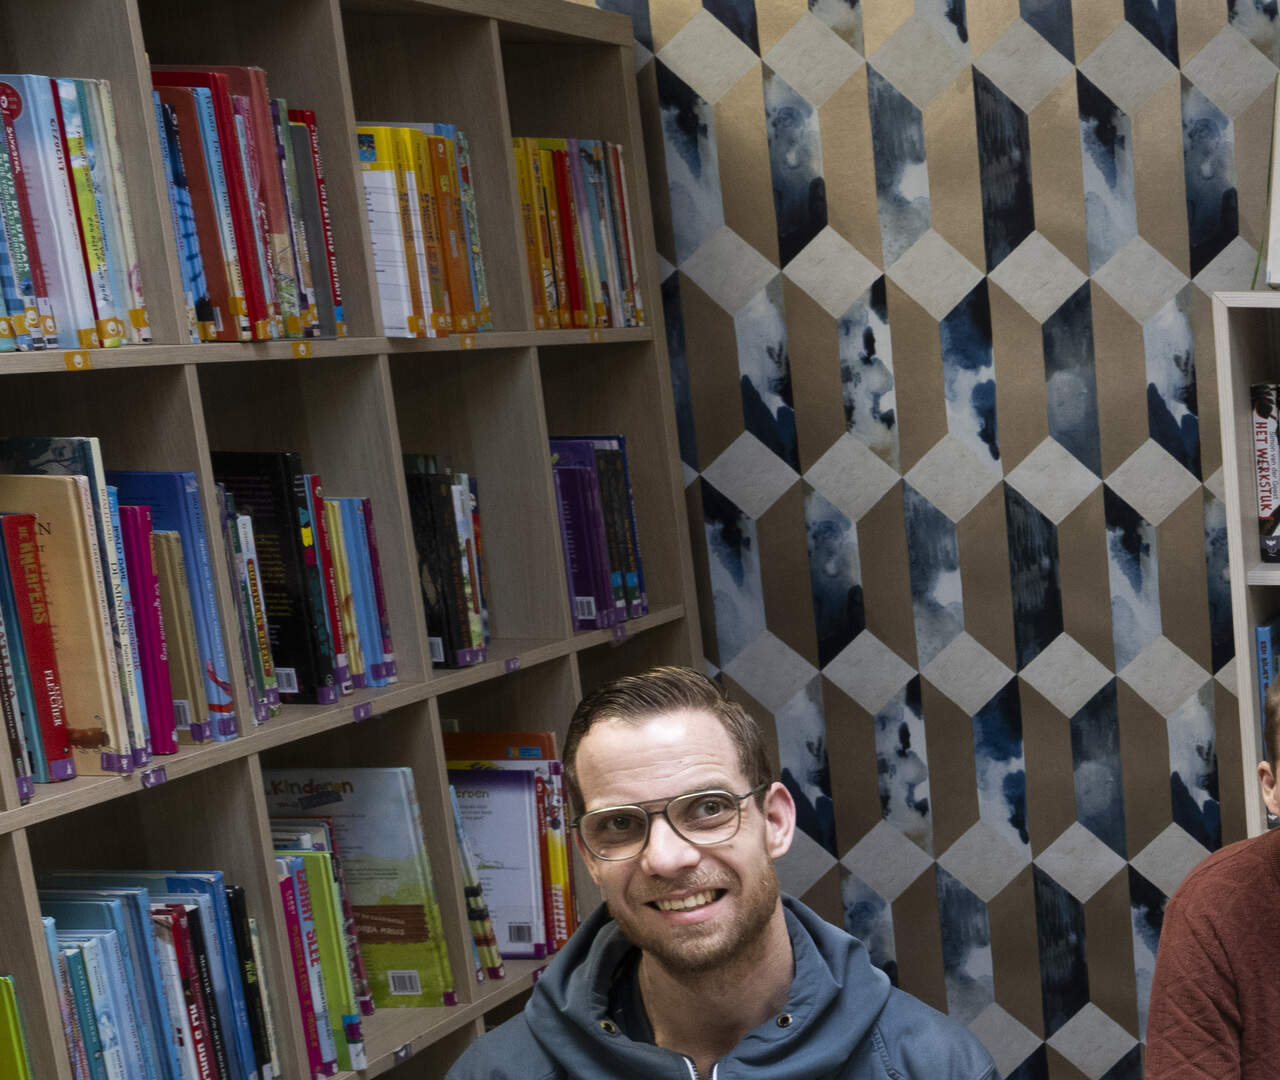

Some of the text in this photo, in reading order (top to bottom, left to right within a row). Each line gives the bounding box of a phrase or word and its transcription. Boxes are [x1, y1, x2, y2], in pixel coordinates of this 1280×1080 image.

[1256, 422, 1271, 512] HET WERKSTUK
[112, 583, 128, 636] MINPINS
